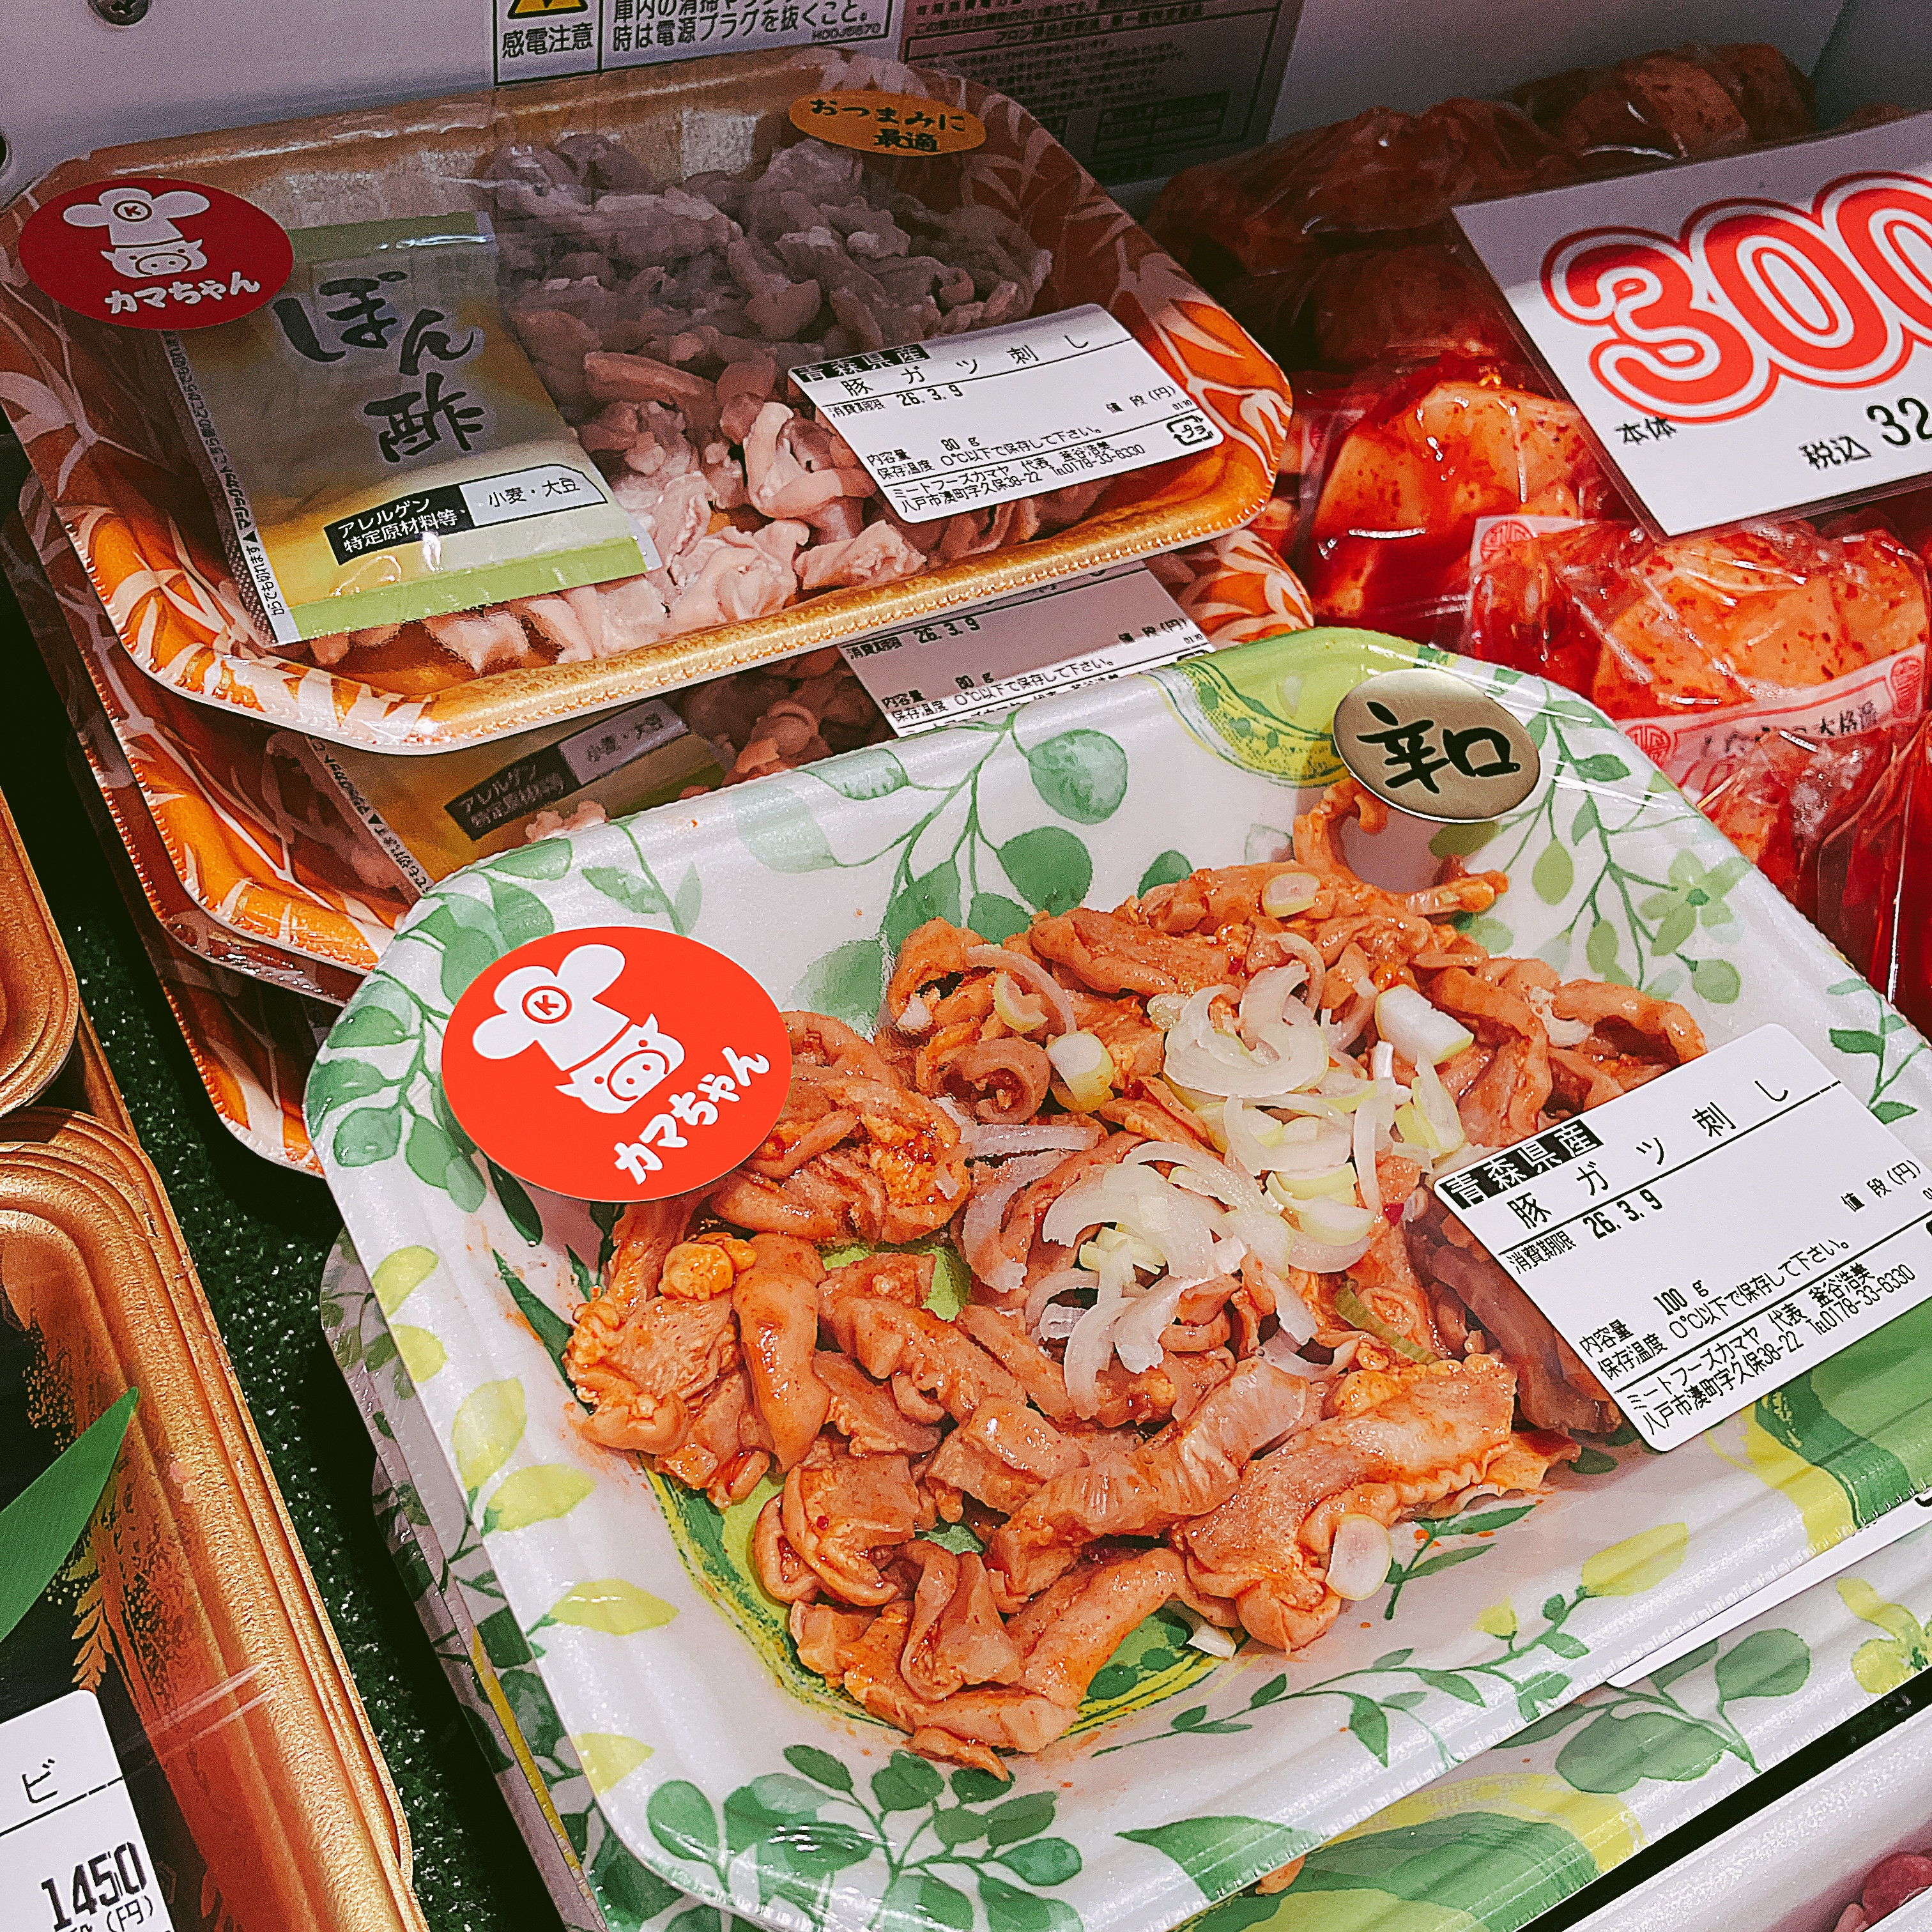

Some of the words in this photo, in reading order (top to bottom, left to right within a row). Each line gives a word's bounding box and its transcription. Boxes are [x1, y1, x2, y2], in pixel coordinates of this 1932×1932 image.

[502, 22, 593, 59] 感電注意
[810, 99, 964, 132] おつまみに
[873, 128, 940, 152] 最適
[105, 272, 260, 313] カマちゃん
[799, 345, 926, 381] 青森県産
[1616, 417, 1677, 443] 本体
[878, 459, 935, 479] 保存温度
[1798, 436, 1871, 470] 税込
[488, 477, 581, 508] 小麦・大豆
[338, 498, 429, 538] アレルゲン
[343, 509, 458, 553] 特定原材料等
[1356, 702, 1521, 794] 辛口
[533, 995, 559, 1015] K
[614, 1046, 770, 1184] カマちゃん
[1446, 1124, 1597, 1208] 青森県産
[1507, 1230, 1576, 1274] 消費期限
[1579, 1319, 1634, 1357] 内容量
[1653, 1288, 1687, 1316] 100
[1598, 1333, 1668, 1381] 保存温度
[1627, 1326, 1759, 1410] ミートフーズカマヤ
[1768, 1303, 1807, 1332] 代表
[22, 1758, 58, 1804] ビ
[41, 1841, 147, 1932] 1450
